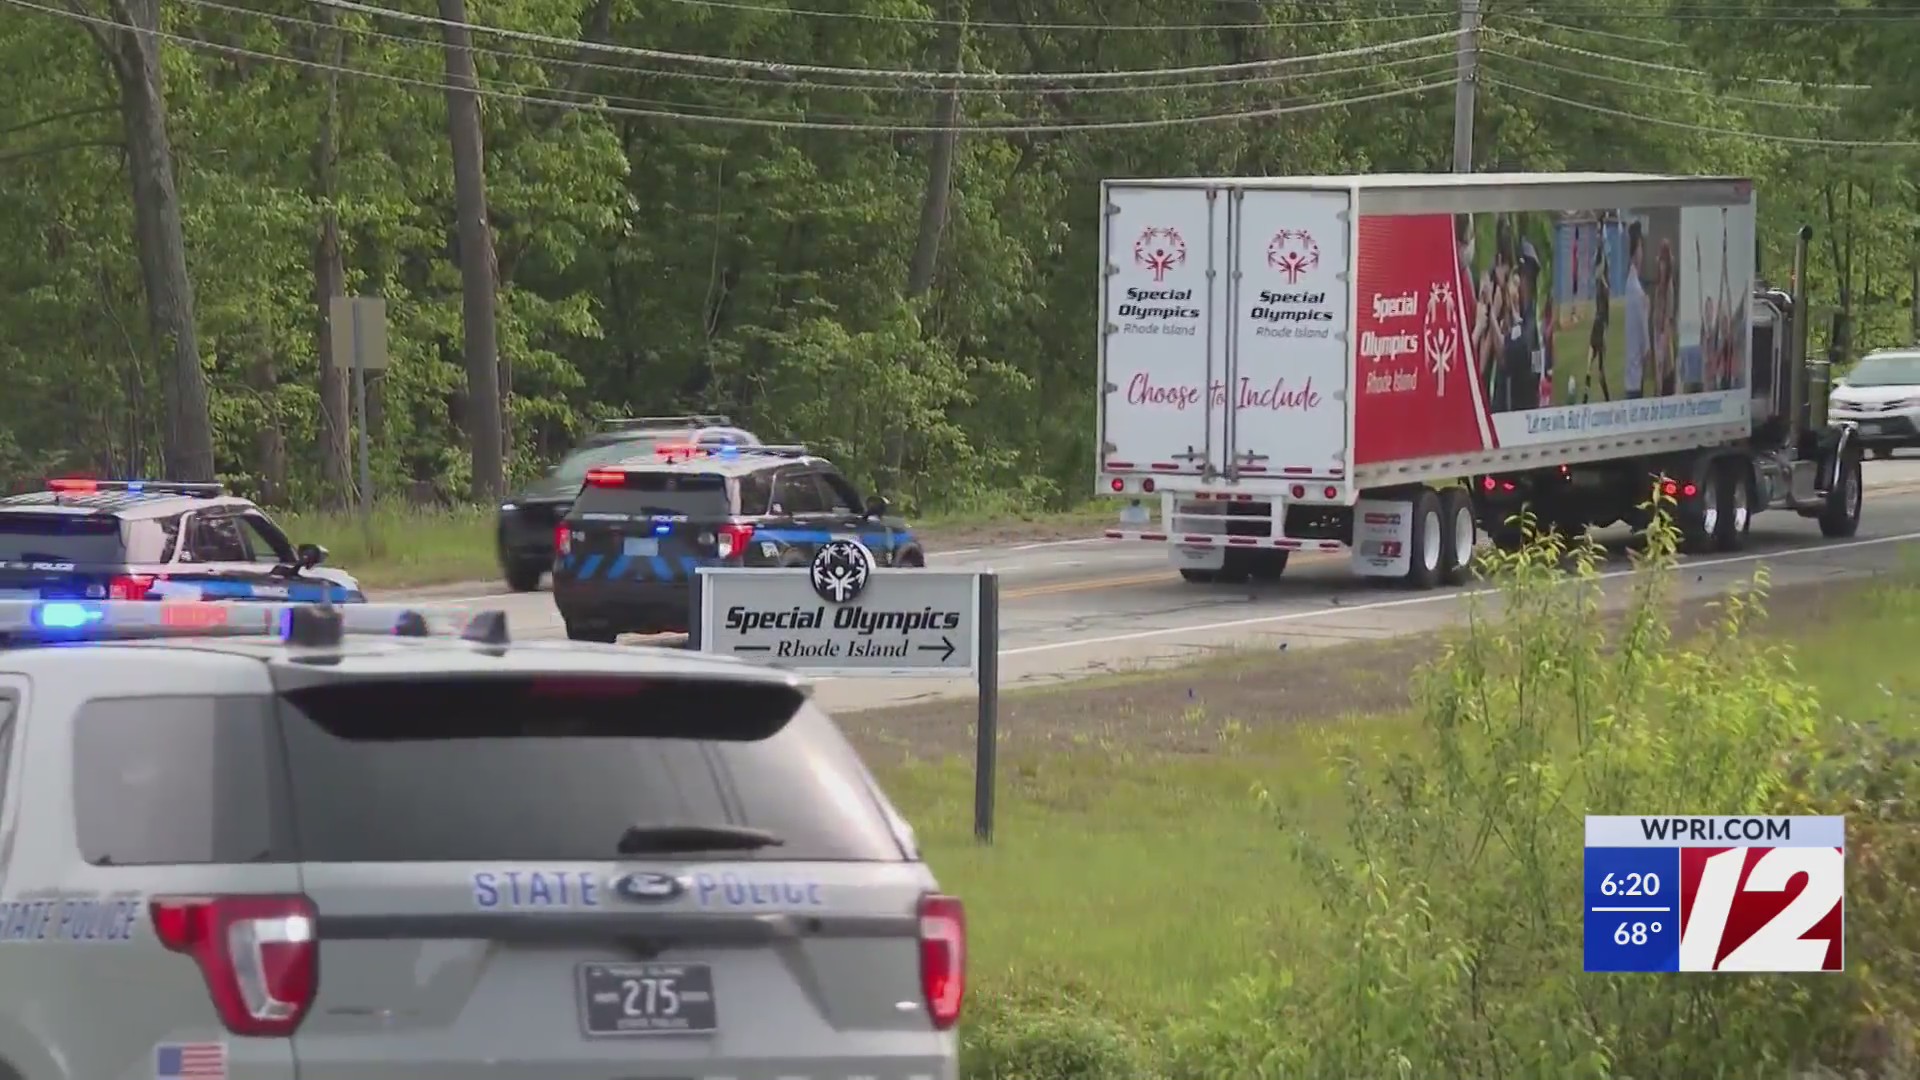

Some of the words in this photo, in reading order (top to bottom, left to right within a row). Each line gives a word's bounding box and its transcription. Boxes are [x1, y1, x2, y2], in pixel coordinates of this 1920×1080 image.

[1127, 287, 1192, 301] Special
[1259, 291, 1325, 305] Special
[1118, 304, 1200, 319] Olympics
[1251, 307, 1333, 322] Olympics
[1373, 291, 1418, 323] Special
[1123, 323, 1160, 335] Rhode
[1163, 324, 1196, 336] Island
[1256, 326, 1291, 338] Rhode
[1295, 327, 1329, 339] Island
[1361, 329, 1418, 361] Olympics
[1127, 373, 1198, 410] Choose
[1208, 379, 1226, 409] to
[1236, 376, 1321, 410] Include
[725, 606, 825, 635] Special
[834, 606, 960, 636] Olympics
[777, 639, 840, 657] Rhode
[846, 639, 909, 657] Island
[474, 871, 598, 907] STATE
[698, 872, 822, 906] POLICE
[60, 900, 140, 939] POLICE
[621, 978, 680, 1016] 275
